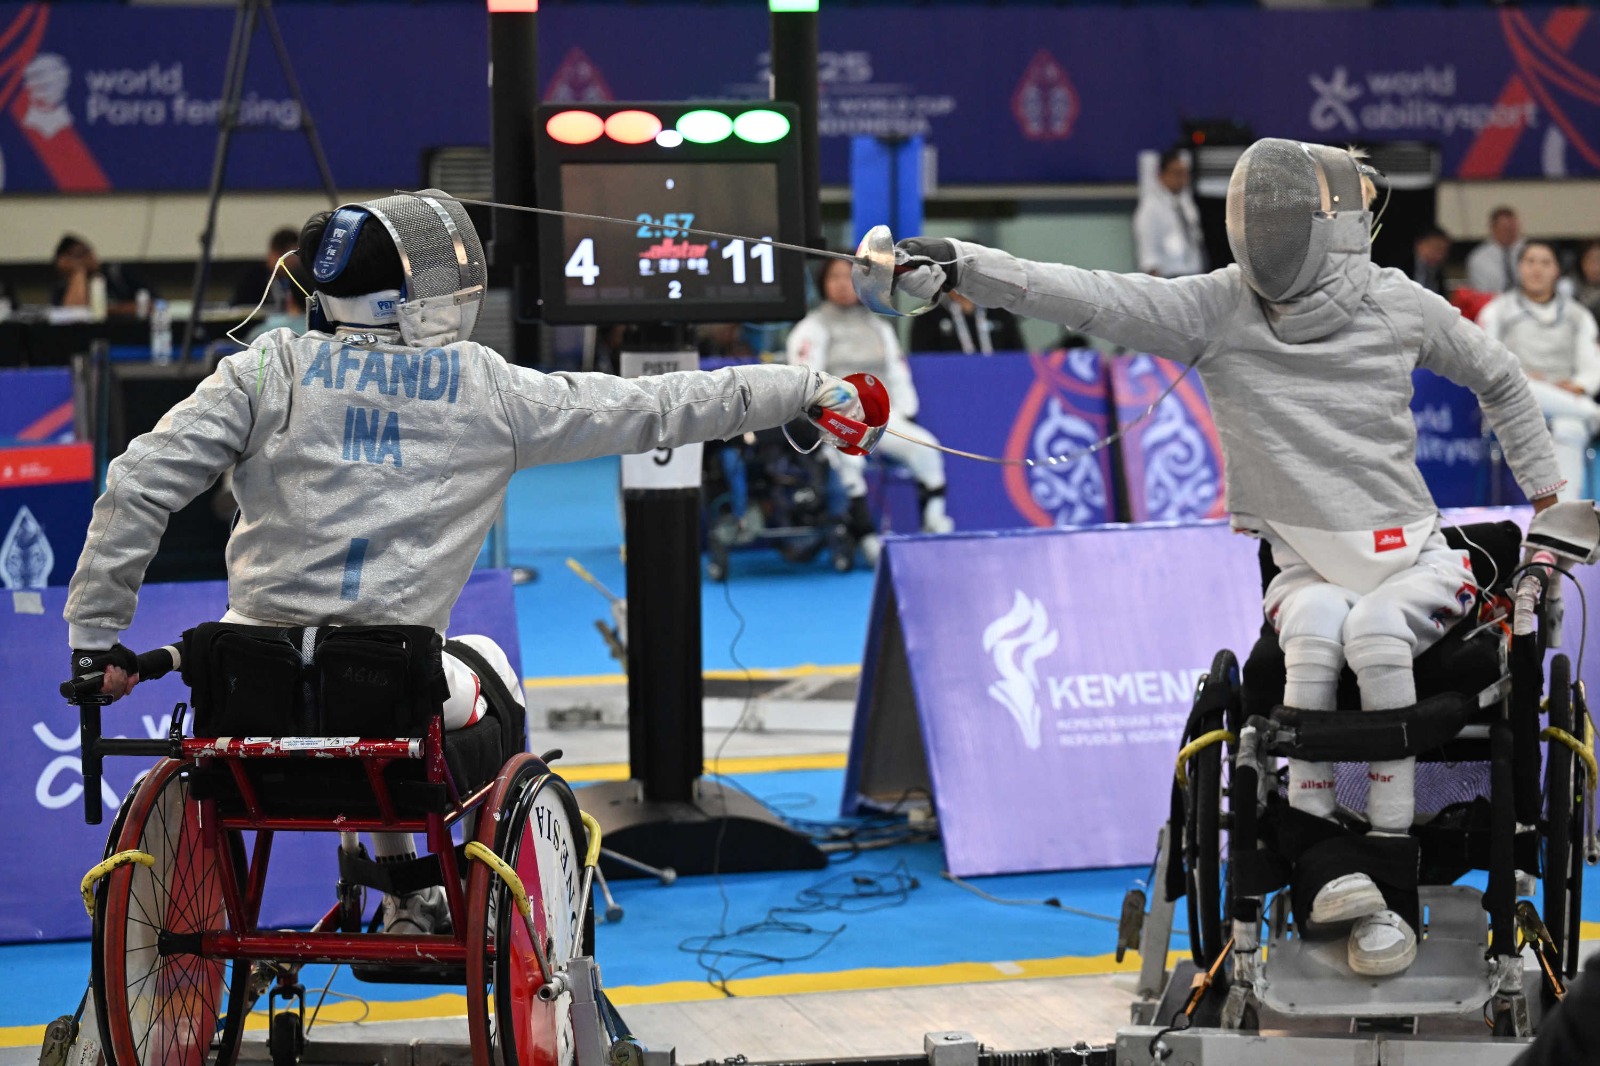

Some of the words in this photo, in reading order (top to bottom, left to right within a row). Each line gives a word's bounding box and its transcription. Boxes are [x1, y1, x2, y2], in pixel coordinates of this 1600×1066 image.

[86, 62, 183, 94] world
[1366, 66, 1456, 96] world
[86, 93, 166, 126] Para
[636, 213, 695, 238] 2:57
[565, 238, 599, 285] 4
[722, 236, 775, 284] 11
[668, 280, 682, 298] 2
[301, 342, 460, 403] AFANDI
[342, 406, 402, 467] INA
